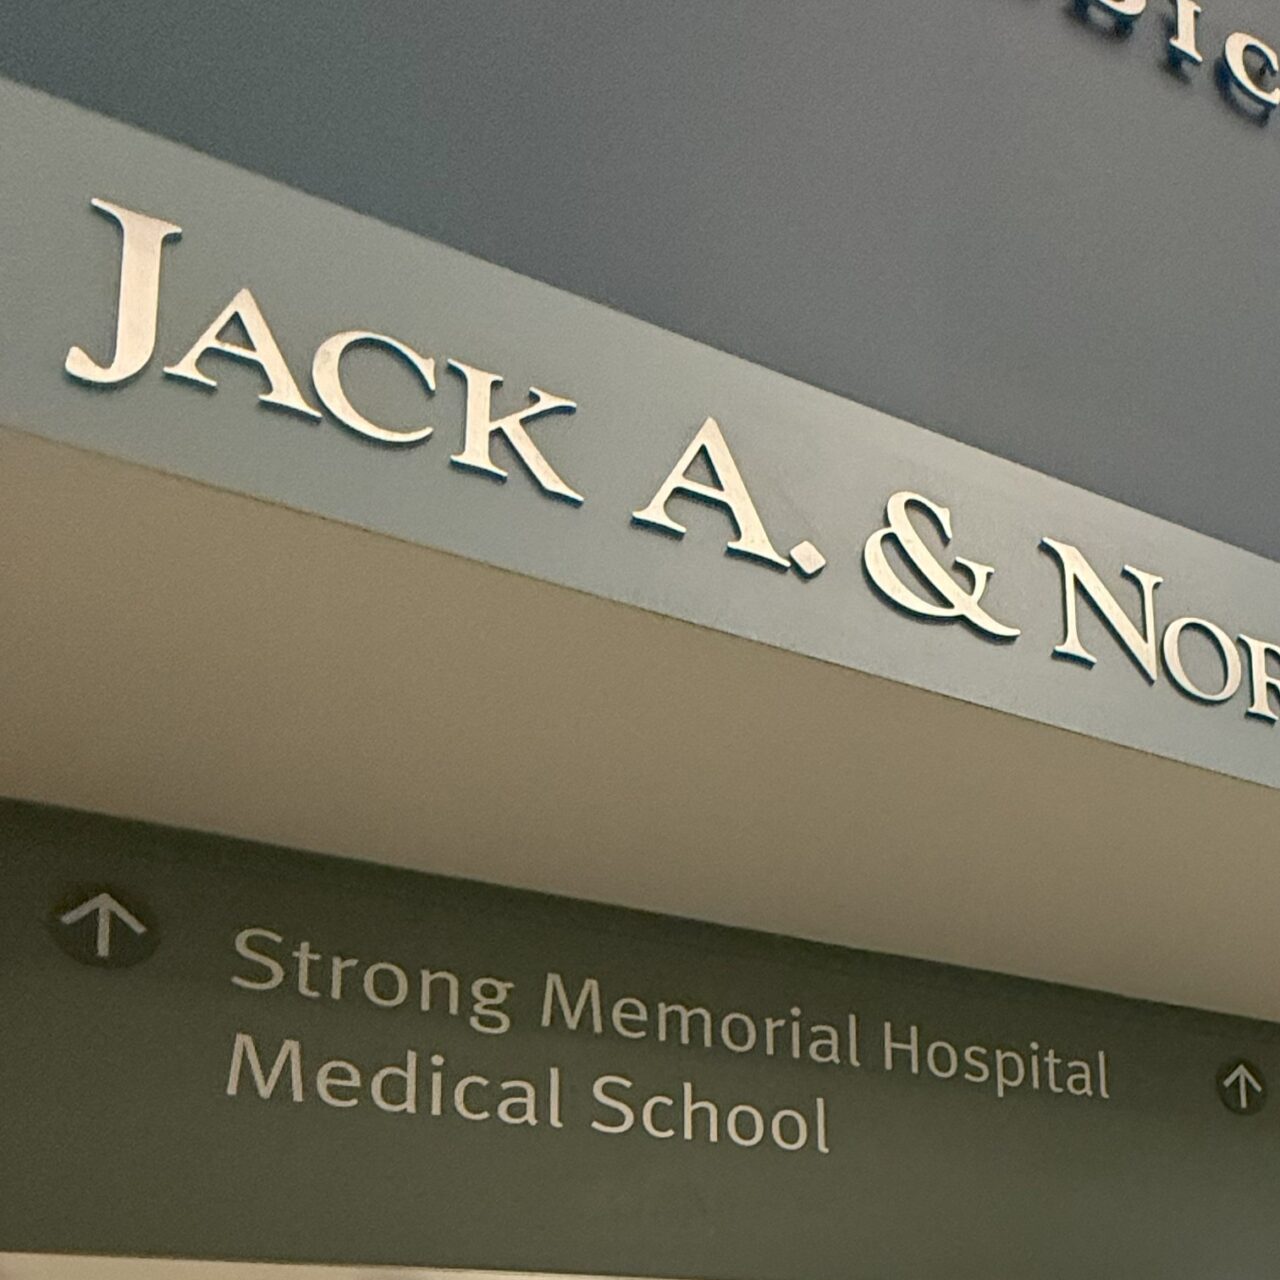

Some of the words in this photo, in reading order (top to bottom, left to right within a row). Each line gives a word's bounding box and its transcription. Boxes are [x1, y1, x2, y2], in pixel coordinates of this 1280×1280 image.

[64, 198, 584, 504] JACK
[632, 417, 827, 577] A.
[863, 490, 1020, 639] &
[226, 1032, 563, 1128] Medical
[590, 1075, 829, 1153] School
[230, 927, 515, 1034] Strong
[541, 972, 860, 1068] Memorial
[884, 1022, 1110, 1098] Hospital
